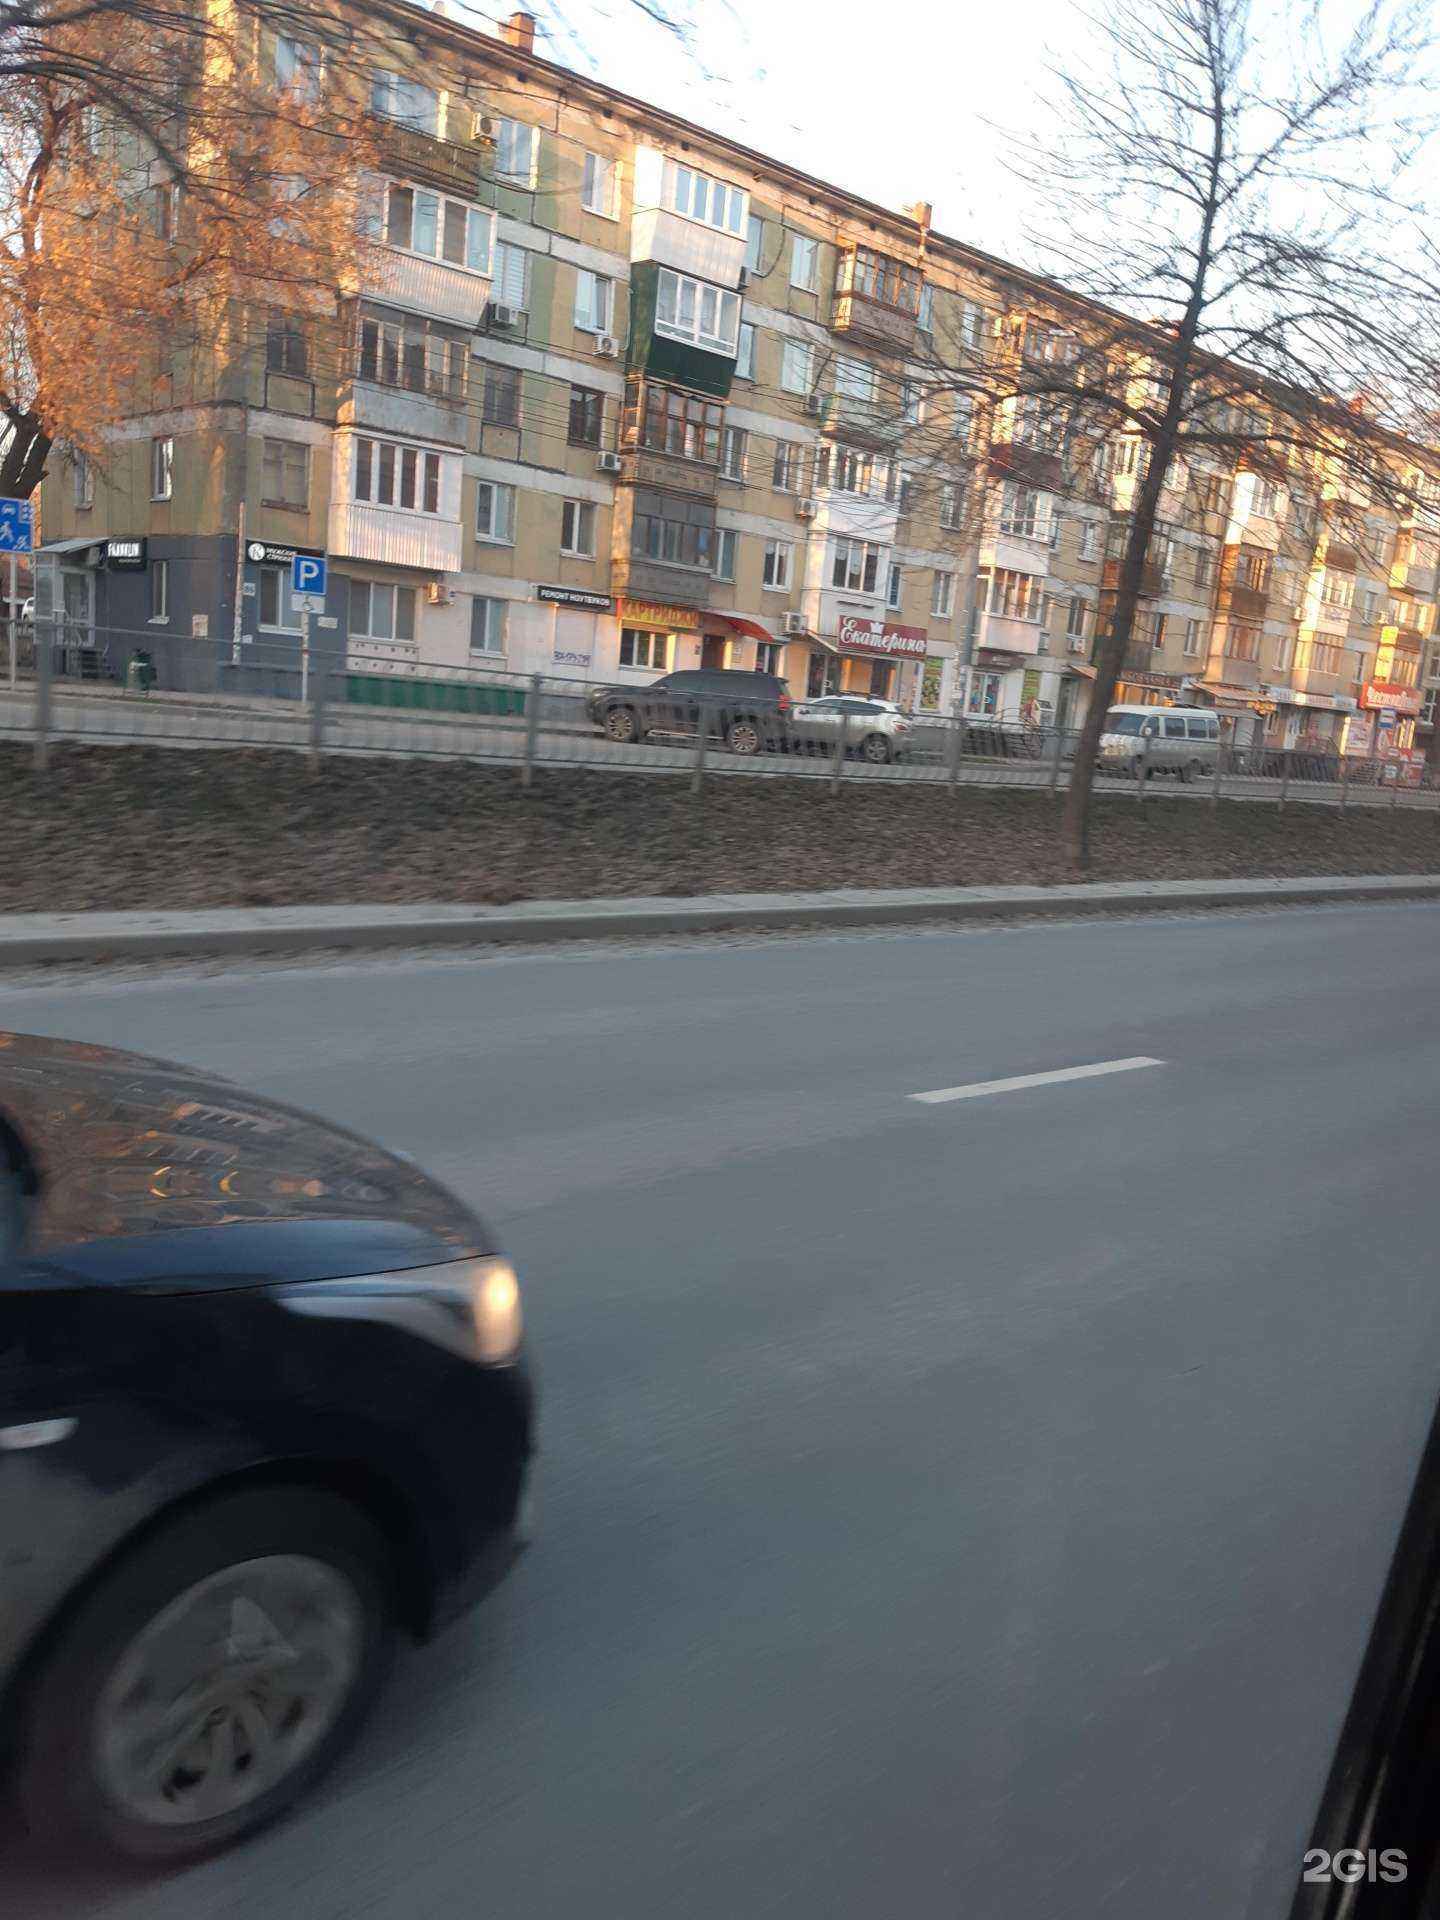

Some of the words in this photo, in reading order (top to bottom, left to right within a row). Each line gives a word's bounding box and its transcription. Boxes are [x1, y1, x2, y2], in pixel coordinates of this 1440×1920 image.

[299, 560, 320, 589] P
[540, 589, 569, 600] РЕМОНТ
[840, 616, 928, 653] Екатерина
